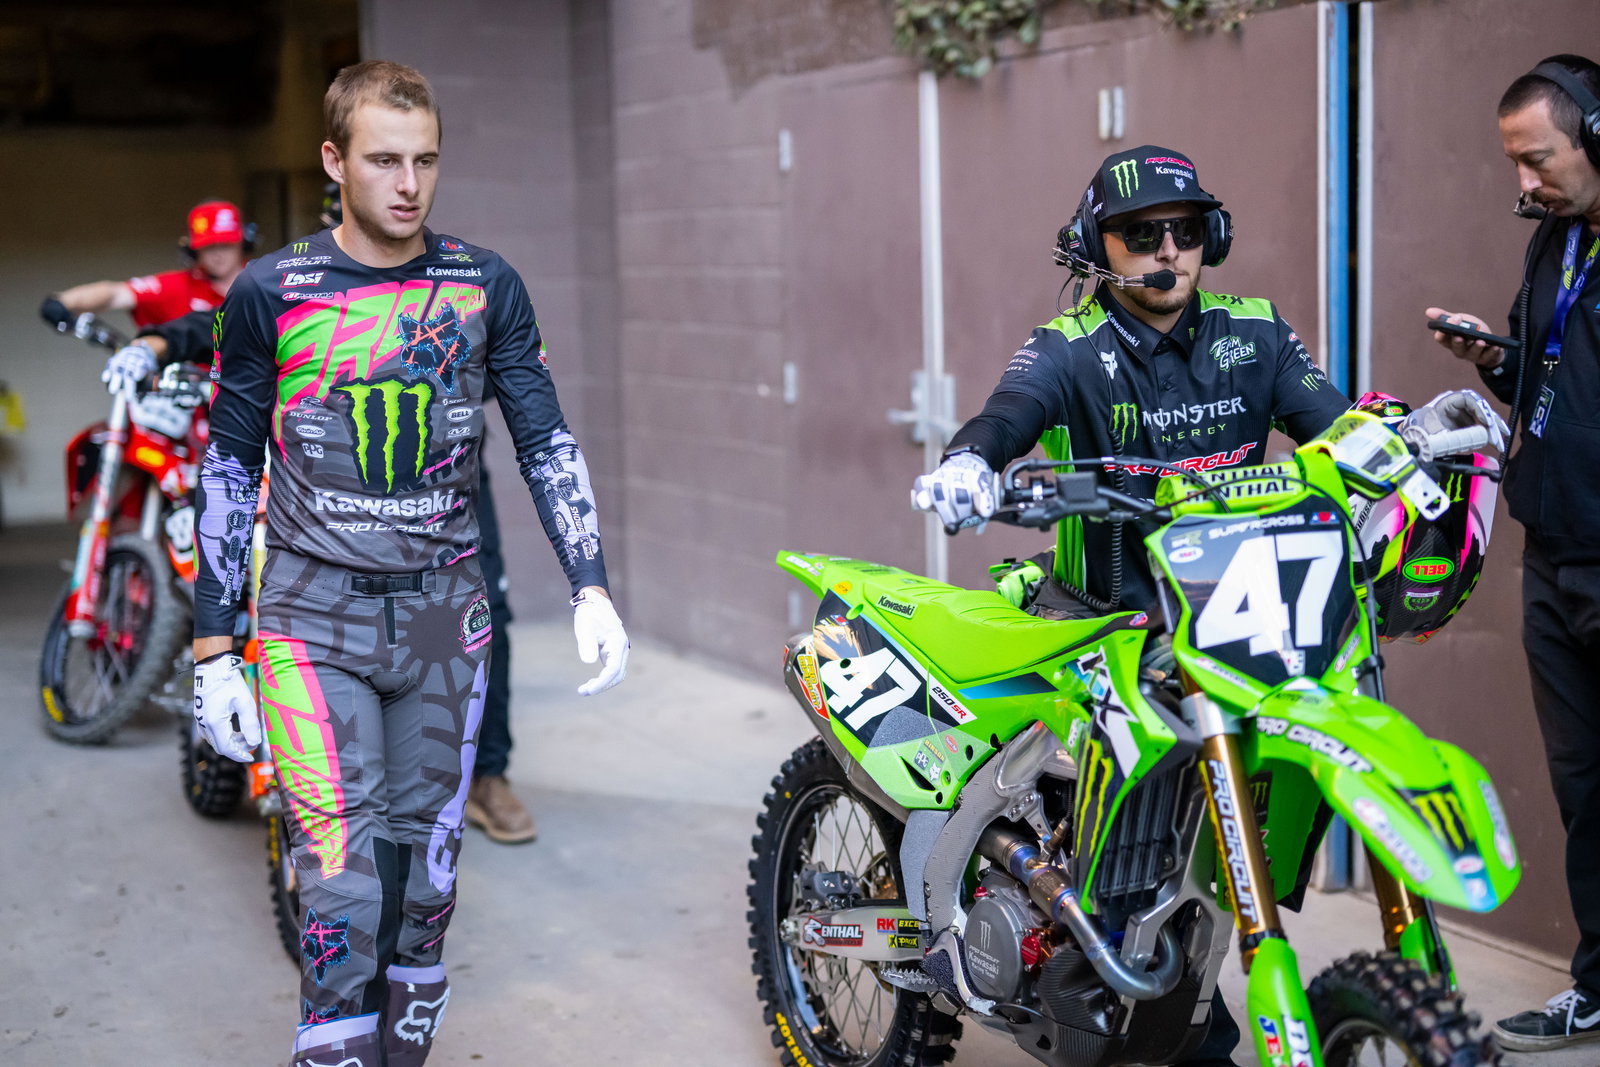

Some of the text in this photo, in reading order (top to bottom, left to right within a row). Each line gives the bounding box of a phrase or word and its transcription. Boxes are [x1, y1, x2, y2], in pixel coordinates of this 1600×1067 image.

[1155, 166, 1194, 180] Kawasaki
[426, 266, 482, 277] Kawasaki
[1105, 309, 1141, 348] Kawasaki
[1210, 337, 1242, 358] TEAM
[1220, 343, 1255, 370] GREEN
[289, 411, 333, 421] DUNLOP
[451, 410, 470, 419] BELL
[1142, 396, 1247, 431] MONSTER
[303, 444, 323, 456] PPG
[314, 489, 454, 517] Kawasaki
[326, 521, 371, 533] PRO
[570, 505, 586, 533] SHOWA
[1208, 513, 1305, 539] SUPERCROSS
[1412, 563, 1447, 576] BELL
[878, 594, 916, 617] Kawasaki
[1196, 530, 1344, 657] 47
[819, 647, 922, 732] 47
[1286, 723, 1375, 774] CIRCUIT
[1208, 759, 1258, 924] PRO CIRCUIT
[877, 918, 896, 931] RK
[898, 920, 921, 928] EXCE
[968, 950, 999, 975] Kawasaki
